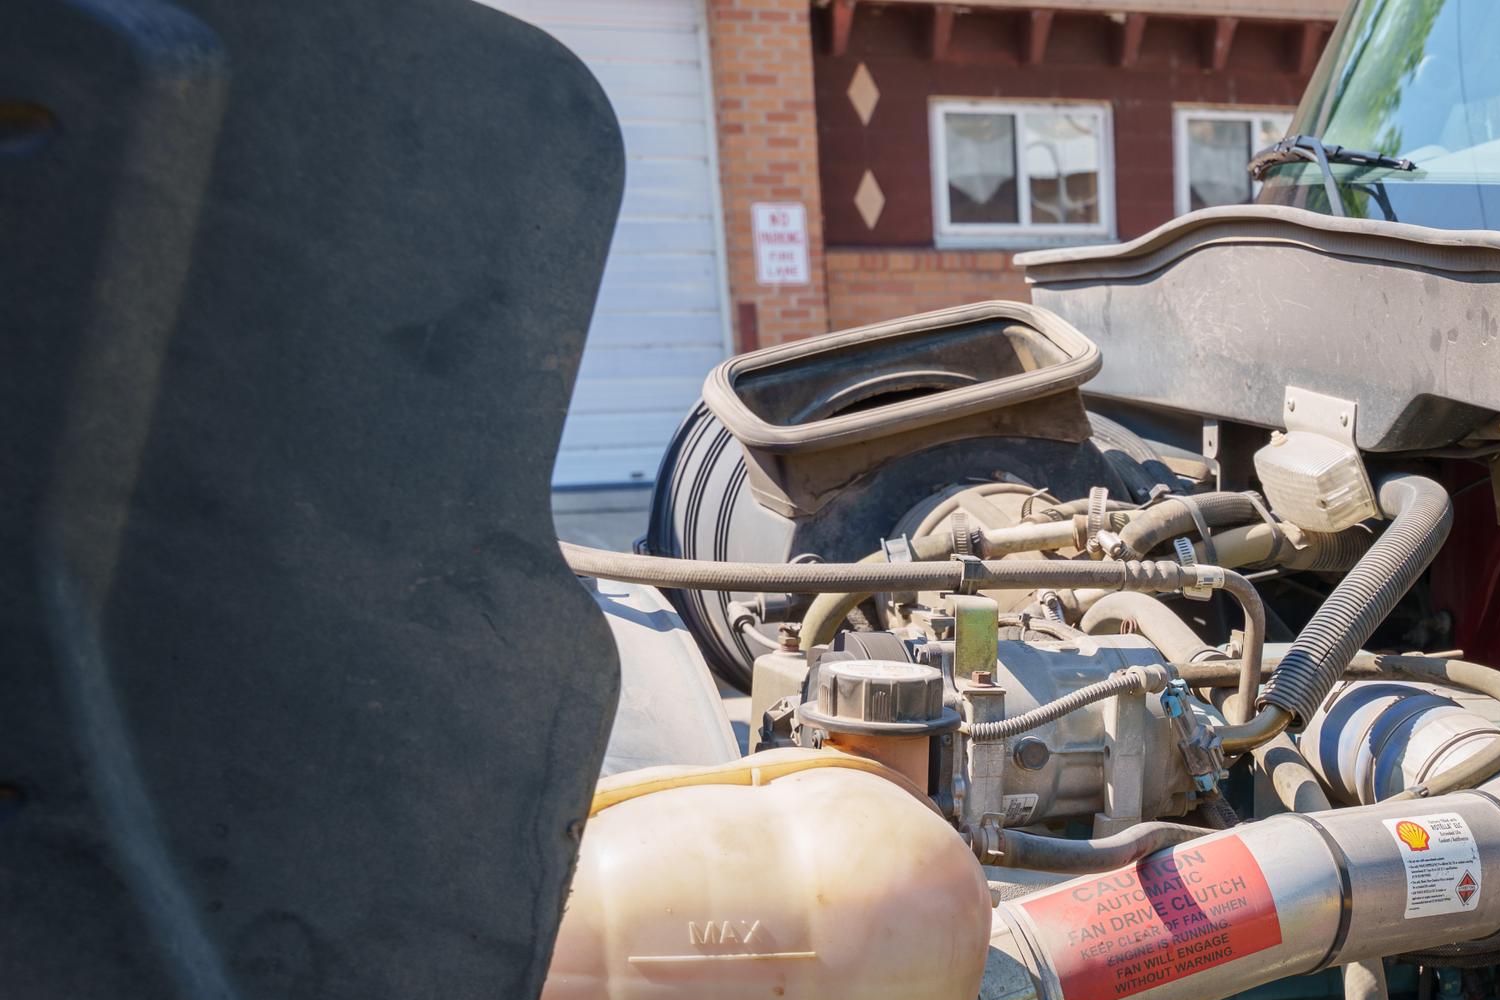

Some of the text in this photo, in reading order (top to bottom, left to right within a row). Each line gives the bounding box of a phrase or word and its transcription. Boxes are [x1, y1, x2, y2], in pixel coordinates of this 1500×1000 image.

[1071, 850, 1206, 902] CAUTION
[1097, 871, 1203, 915] AUTOMATIC
[688, 920, 763, 945] MAX
[1069, 876, 1247, 946] FAN DRIVE CLUTCH
[1081, 897, 1248, 961] KEEP CLEAR OF FAN WHEN
[1106, 920, 1232, 967] ENGINE IS RUNNING.
[1116, 933, 1230, 979] FAN WILL ENGAGE
[1114, 946, 1233, 994] WITHOUT WARNING
